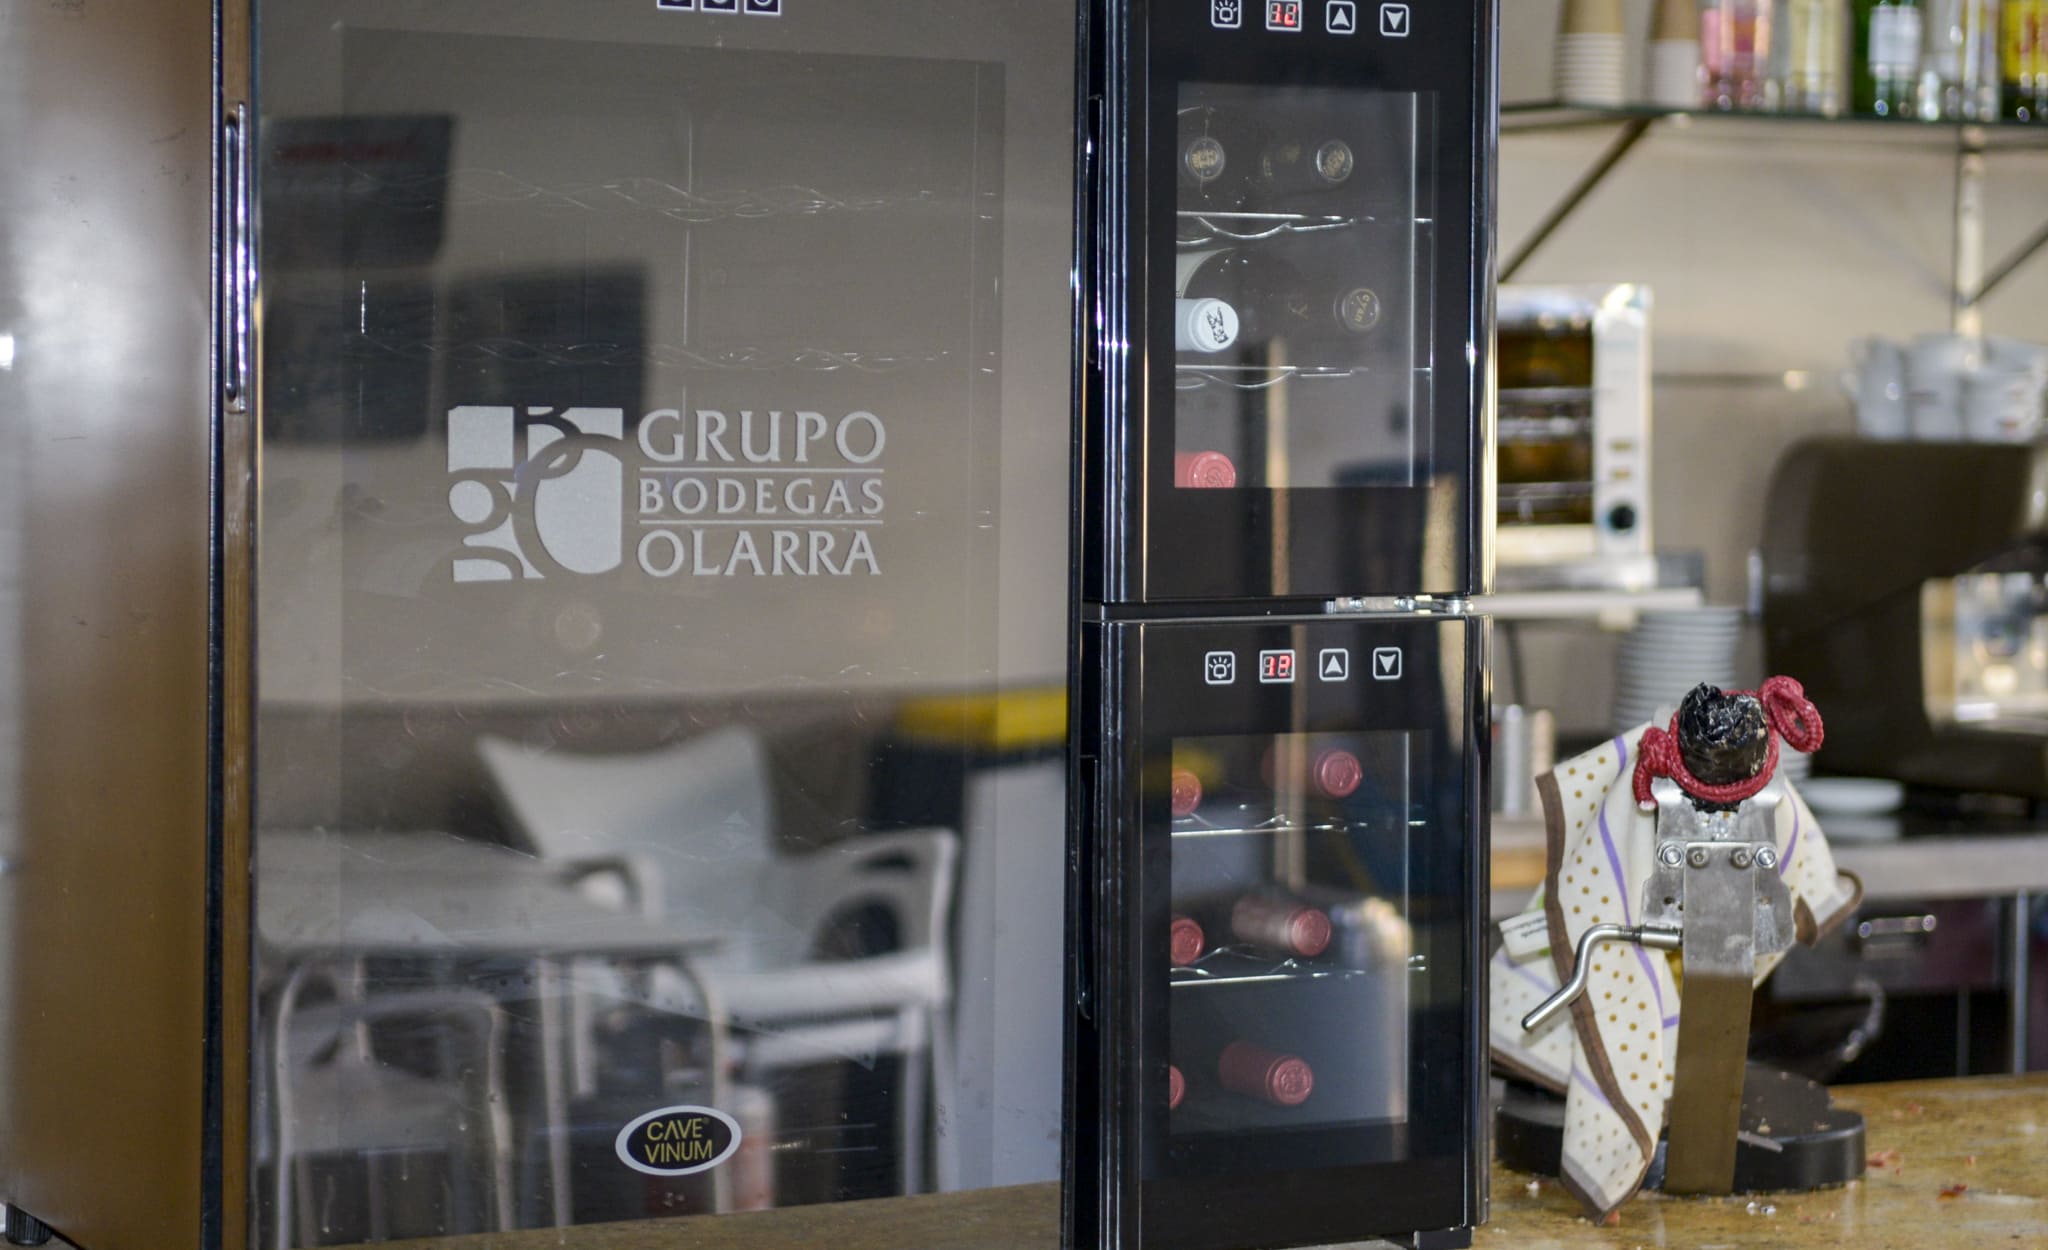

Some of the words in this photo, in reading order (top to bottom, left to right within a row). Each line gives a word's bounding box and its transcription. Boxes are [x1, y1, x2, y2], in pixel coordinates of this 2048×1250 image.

[637, 408, 887, 464] GRUPO
[638, 477, 886, 516] BODEGAS
[636, 529, 883, 578] OLARRA
[646, 1117, 703, 1141] CAVE
[644, 1139, 713, 1164] VINUM
